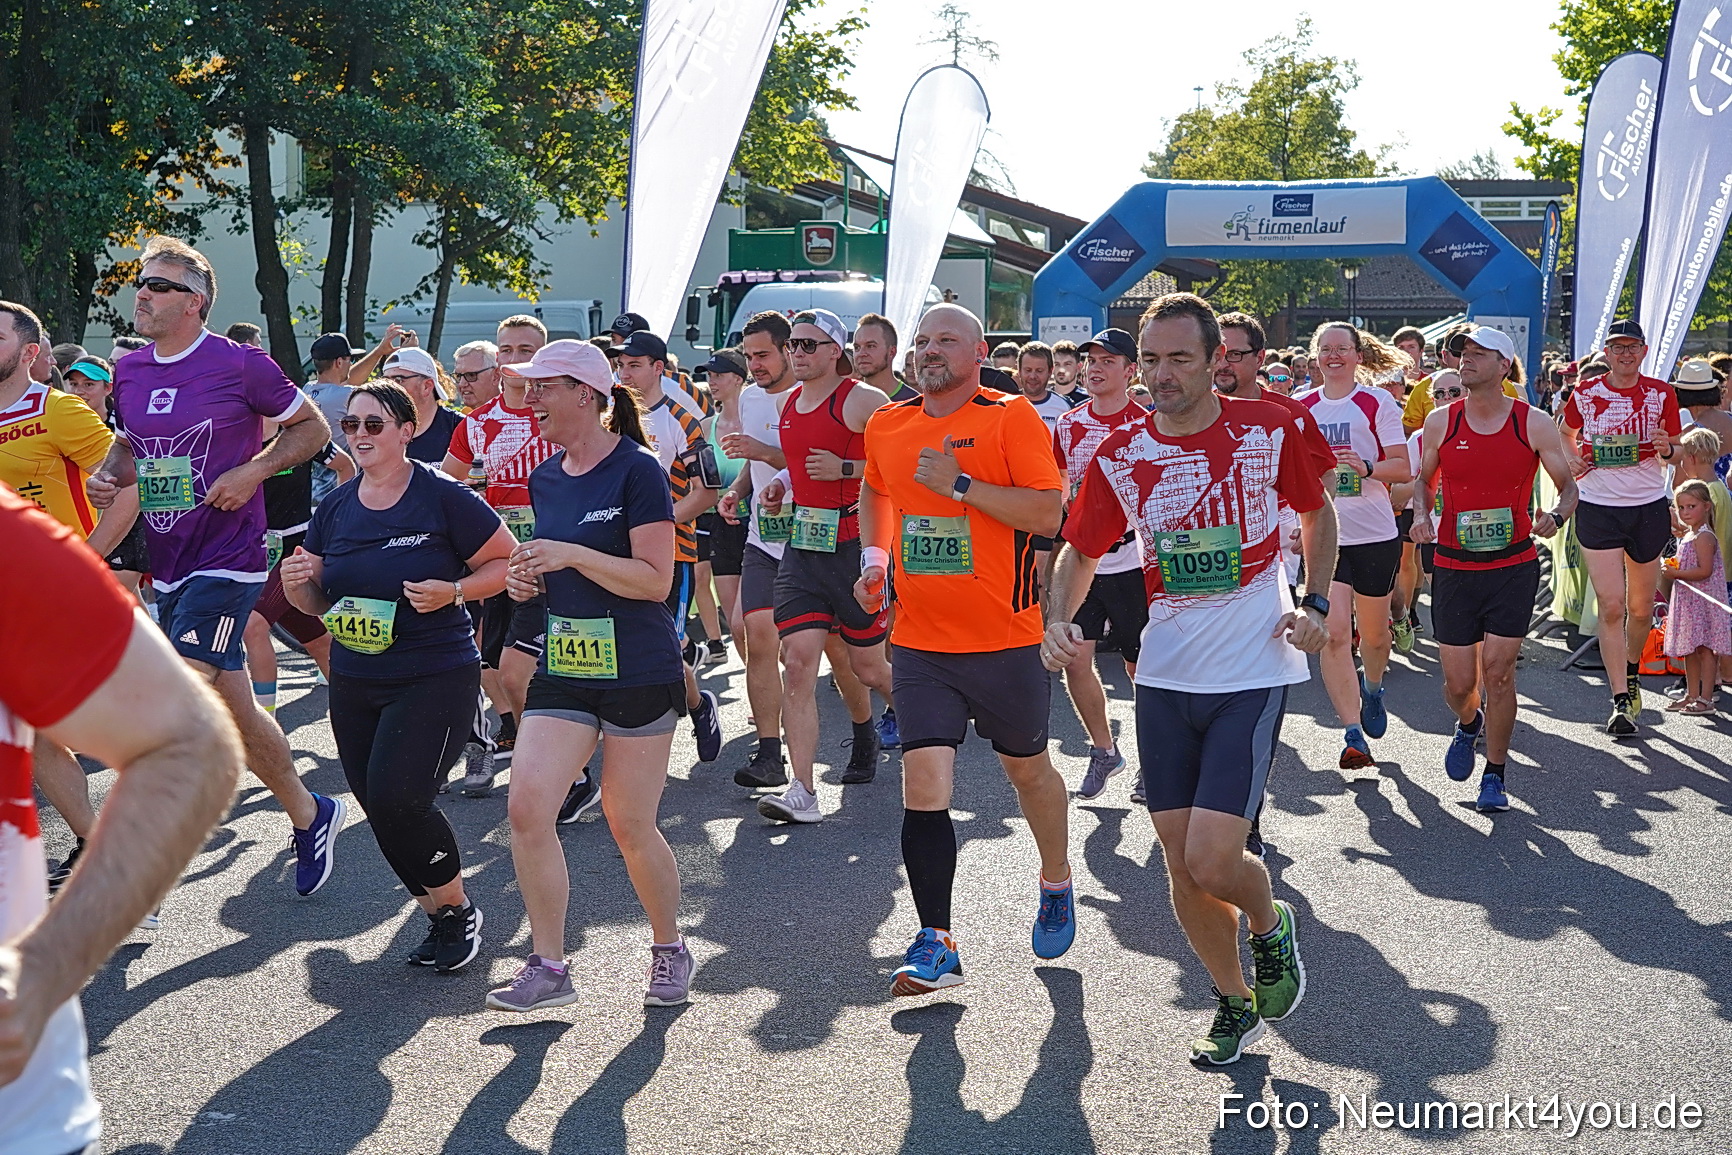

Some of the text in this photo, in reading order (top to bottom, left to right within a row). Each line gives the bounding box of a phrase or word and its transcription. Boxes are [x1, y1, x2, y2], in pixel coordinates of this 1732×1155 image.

[1610, 78, 1653, 181] Fischer
[1258, 216, 1347, 233] firmenlauf
[1087, 246, 1135, 257] Fischer
[951, 438, 975, 448] HULE
[1600, 446, 1631, 457] 1105
[1157, 448, 1181, 459] 10.54
[144, 476, 180, 494] 1527
[182, 478, 191, 502] 2022
[1160, 501, 1187, 513] 26.22
[797, 521, 829, 538] 1155
[1466, 523, 1505, 538] 1158
[911, 536, 959, 556] 1378
[961, 540, 969, 566] 2022
[1162, 560, 1172, 582] RUN
[1170, 550, 1229, 574] 1099
[1231, 551, 1239, 581] 2022
[1196, 573, 1233, 582] Bernhard
[335, 616, 381, 637] 1415
[382, 624, 391, 647] 2022
[358, 637, 383, 646] Gudrun
[556, 638, 600, 659] 1411
[557, 658, 604, 668] Müller Melanie
[604, 643, 613, 669] 2022
